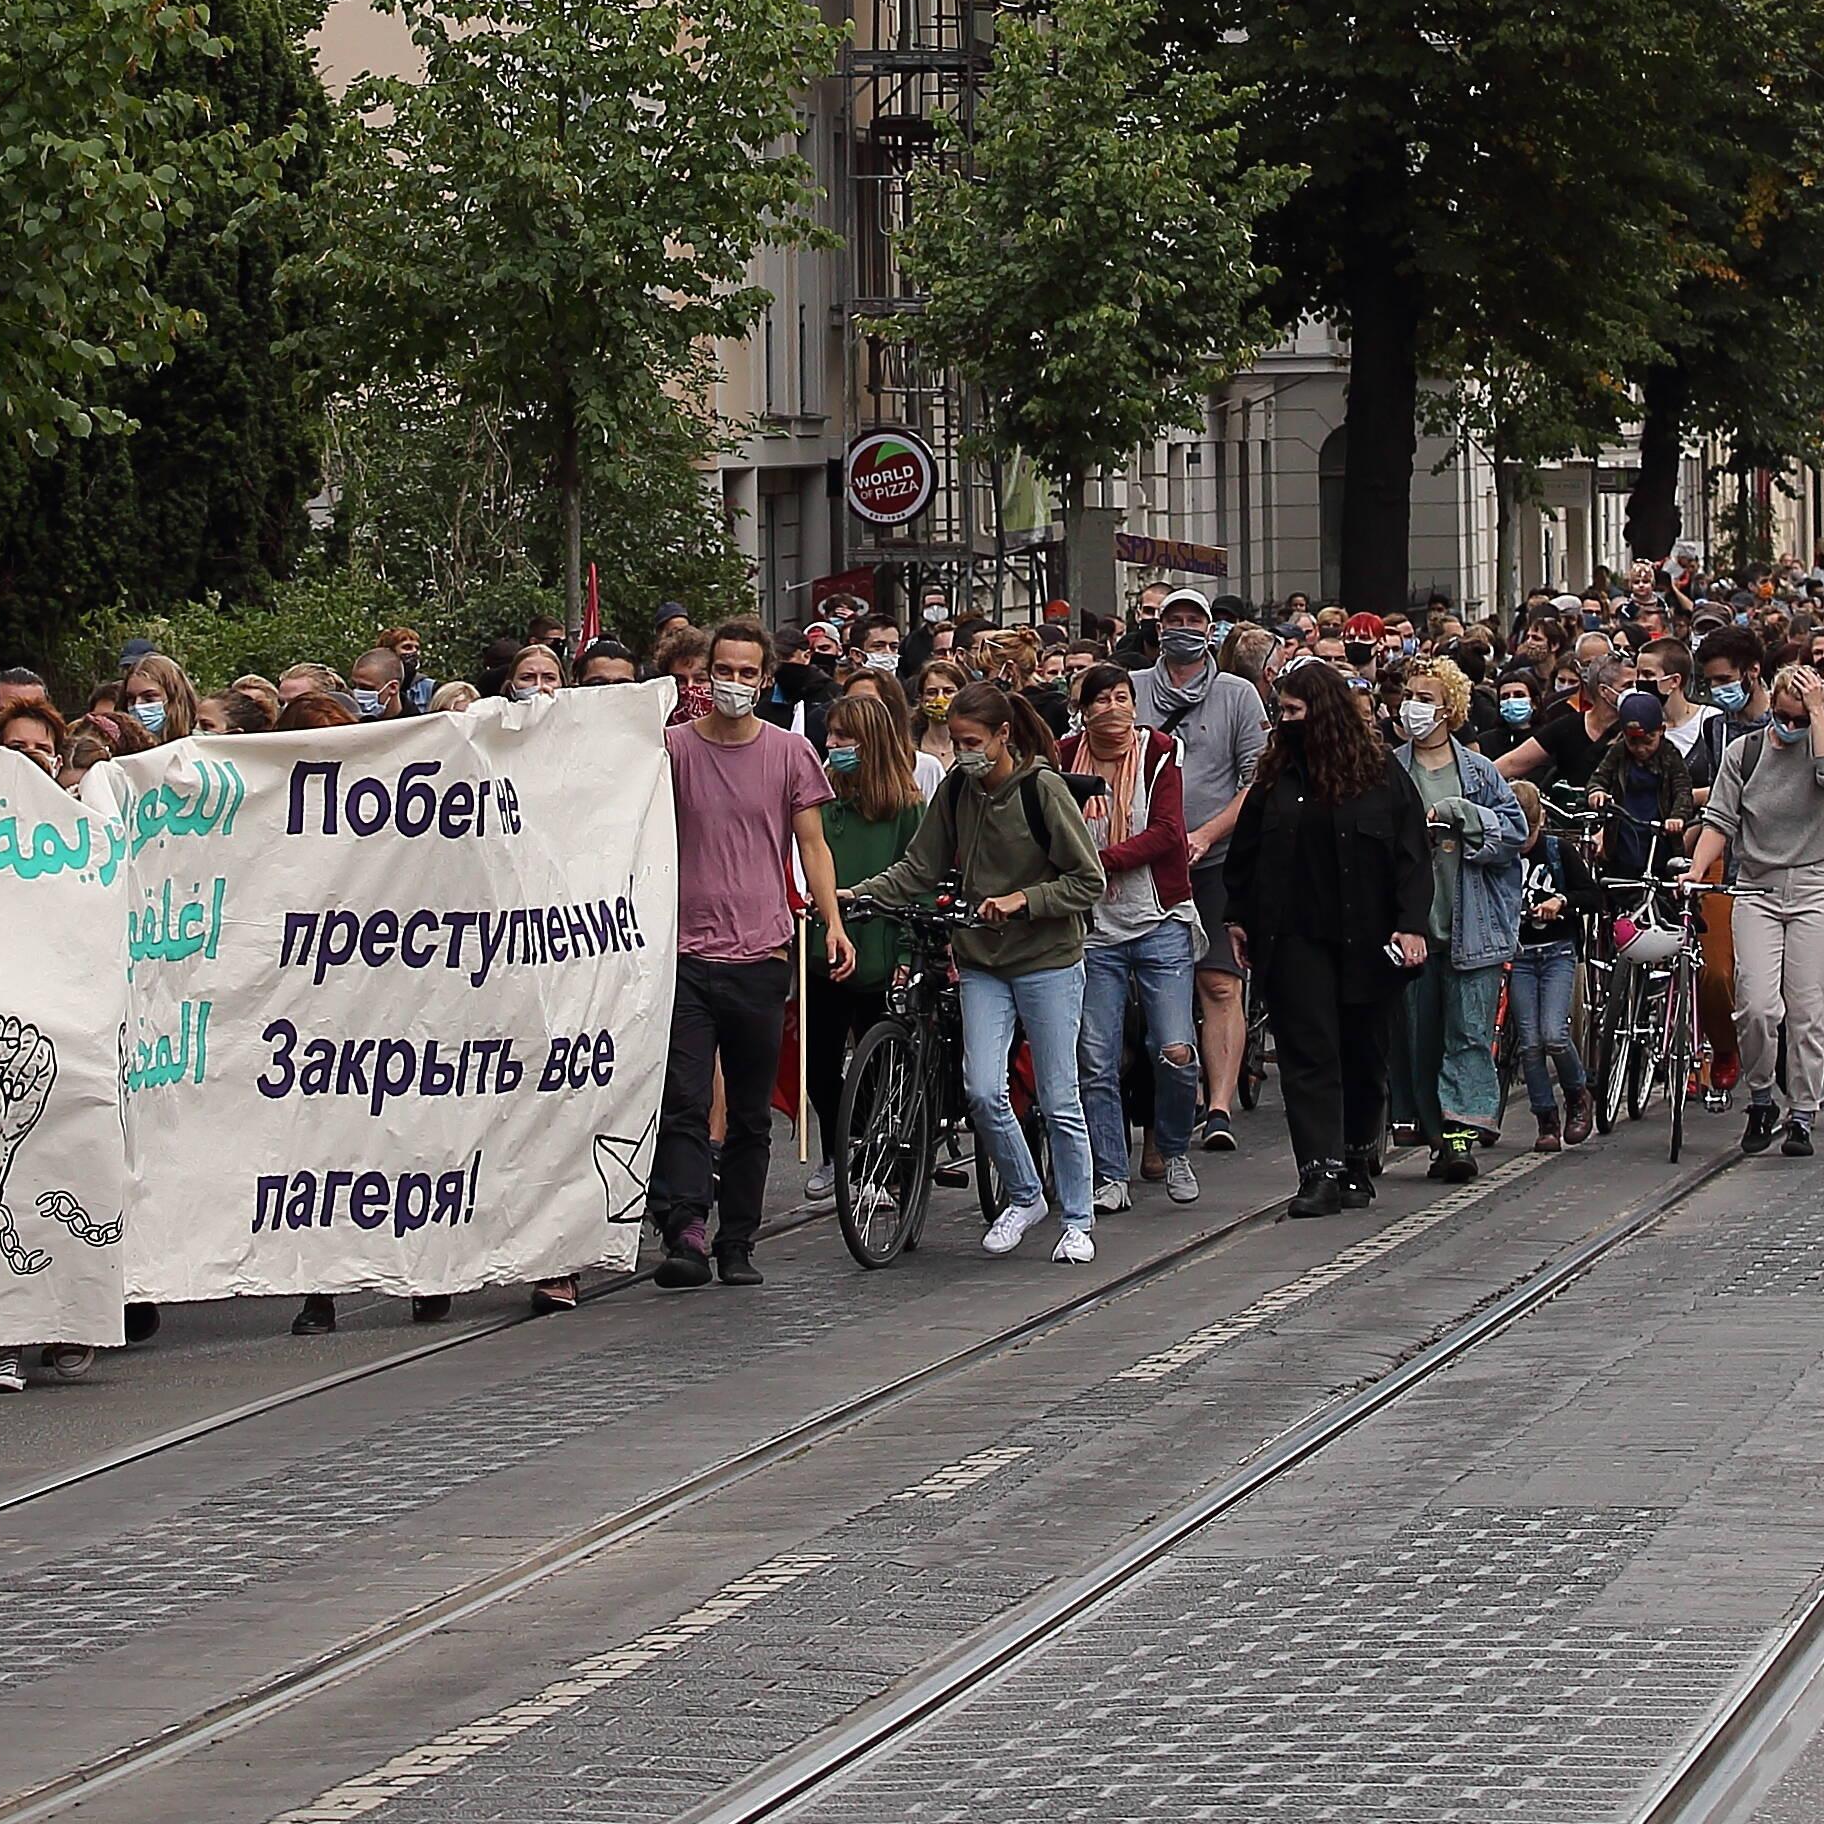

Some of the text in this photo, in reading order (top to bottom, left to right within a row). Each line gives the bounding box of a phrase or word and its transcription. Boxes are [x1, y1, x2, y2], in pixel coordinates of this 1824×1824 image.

[855, 465, 914, 489] WORLD
[860, 479, 920, 501] OF PIZZA
[1116, 533, 1156, 566] SPD
[286, 760, 522, 839] Побег не
[278, 874, 647, 989] преступление!
[257, 1018, 616, 1117] Закрыть все
[251, 1149, 483, 1239] лагеря!
